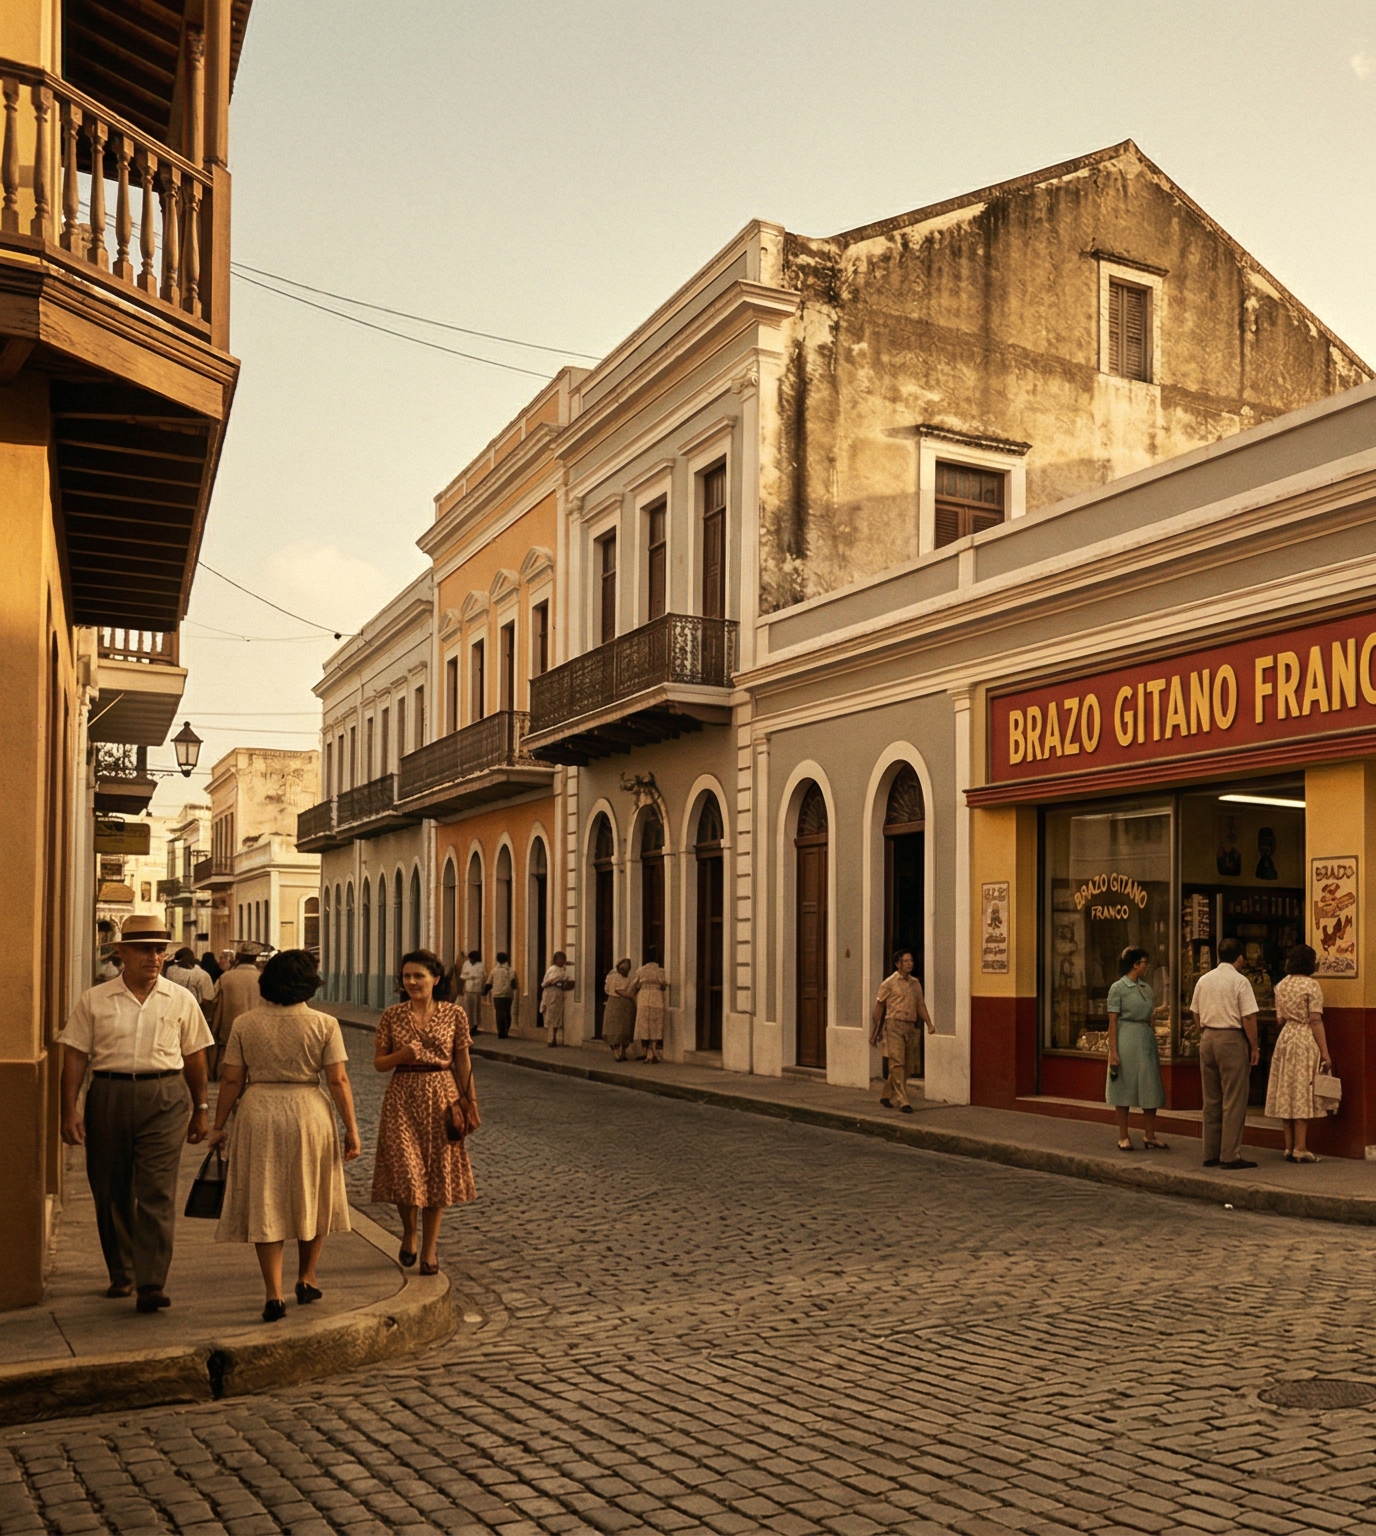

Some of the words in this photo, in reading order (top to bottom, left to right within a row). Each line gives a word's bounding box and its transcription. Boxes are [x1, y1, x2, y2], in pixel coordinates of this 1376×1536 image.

[1009, 693, 1101, 765] BRAZO
[1114, 663, 1238, 747] GITANO
[1074, 873, 1108, 910] BRAZO
[1109, 872, 1148, 909] GITANO
[1091, 904, 1129, 920] FRANCO
